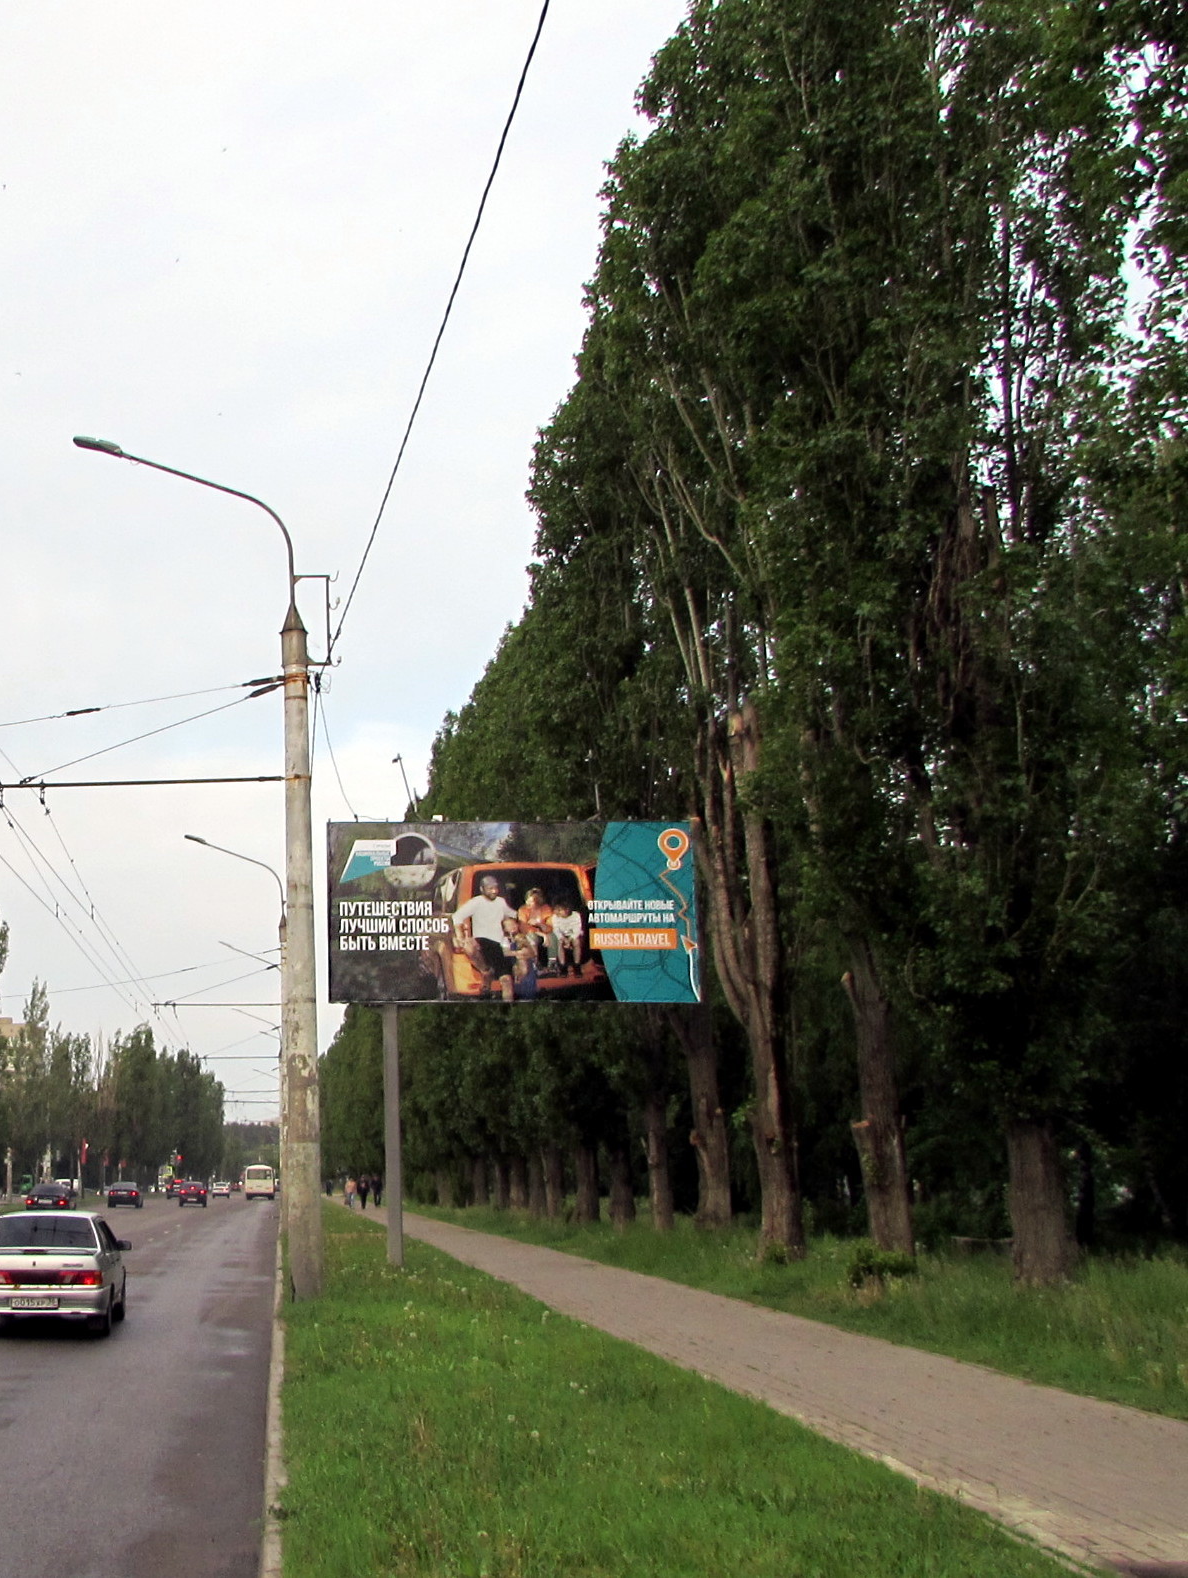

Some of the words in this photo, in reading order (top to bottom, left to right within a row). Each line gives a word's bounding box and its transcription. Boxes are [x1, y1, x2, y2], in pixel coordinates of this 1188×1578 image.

[339, 901, 432, 916] ПУТЕШЕСТВИЯ
[587, 898, 643, 910] ОТКРЫВАЙТЕ
[644, 900, 674, 910] НОВЫЕ
[588, 912, 661, 923] АВТОМАРШРУТЫ
[662, 912, 675, 923] НА
[339, 916, 396, 933] ЛУЧШИЙ
[399, 918, 449, 933] СПОСОБ
[339, 935, 376, 950] БЫТЬ
[379, 935, 429, 950] ВМЕСТЕ
[594, 933, 670, 945] RUSSIA.TRAVEL
